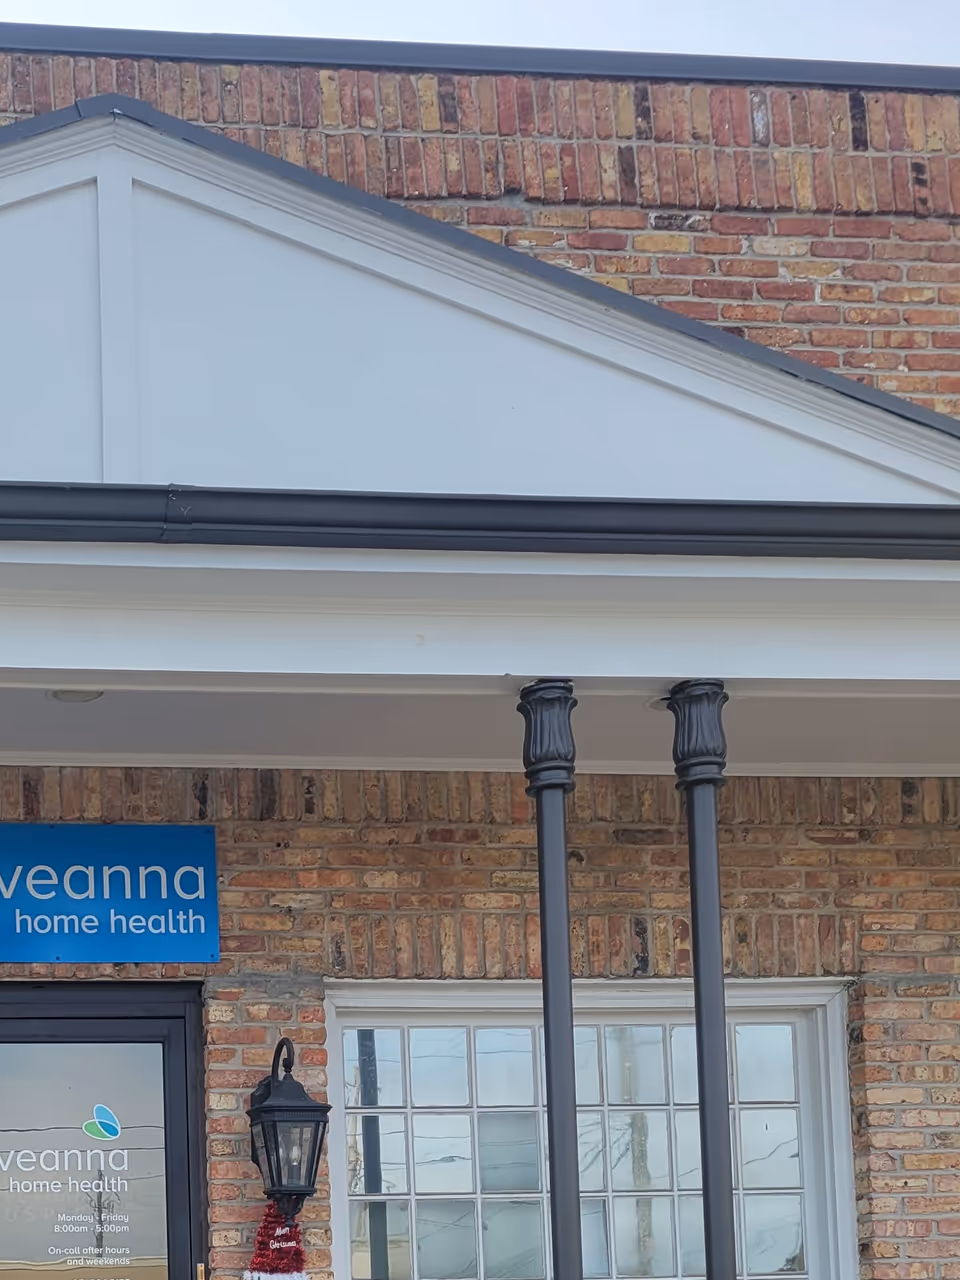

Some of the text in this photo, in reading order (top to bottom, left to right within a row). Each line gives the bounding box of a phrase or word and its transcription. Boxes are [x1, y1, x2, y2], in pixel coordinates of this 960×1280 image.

[15, 908, 206, 934] home health
[9, 1176, 128, 1193] home health
[57, 1213, 94, 1223] Monday
[101, 1213, 129, 1223] Friday
[54, 1224, 88, 1233] 8:00am
[95, 1224, 130, 1233] 5:00pm
[48, 1246, 130, 1255] On-call after hours
[66, 1257, 131, 1266] and weekends
